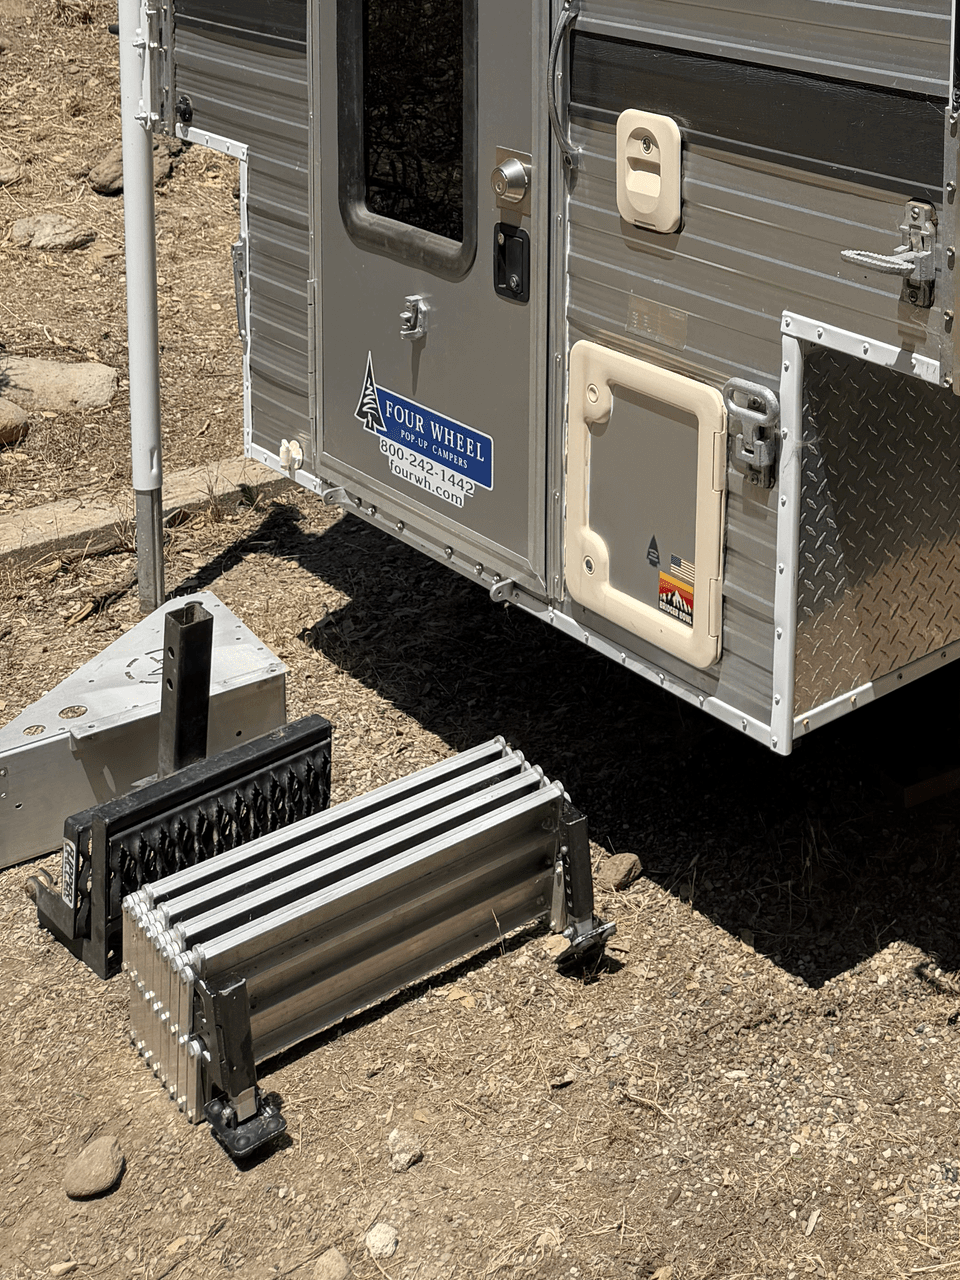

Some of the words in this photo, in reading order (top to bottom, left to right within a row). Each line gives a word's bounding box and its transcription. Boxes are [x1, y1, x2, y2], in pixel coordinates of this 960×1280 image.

[385, 399, 425, 434] FOUR
[430, 420, 485, 462] WHEEL
[400, 429, 429, 450] POP-UP
[432, 444, 468, 469] CAMPERS
[380, 439, 475, 496] 800-242-1442
[389, 459, 463, 506] fourwh.com
[679, 610, 692, 624] BOWL
